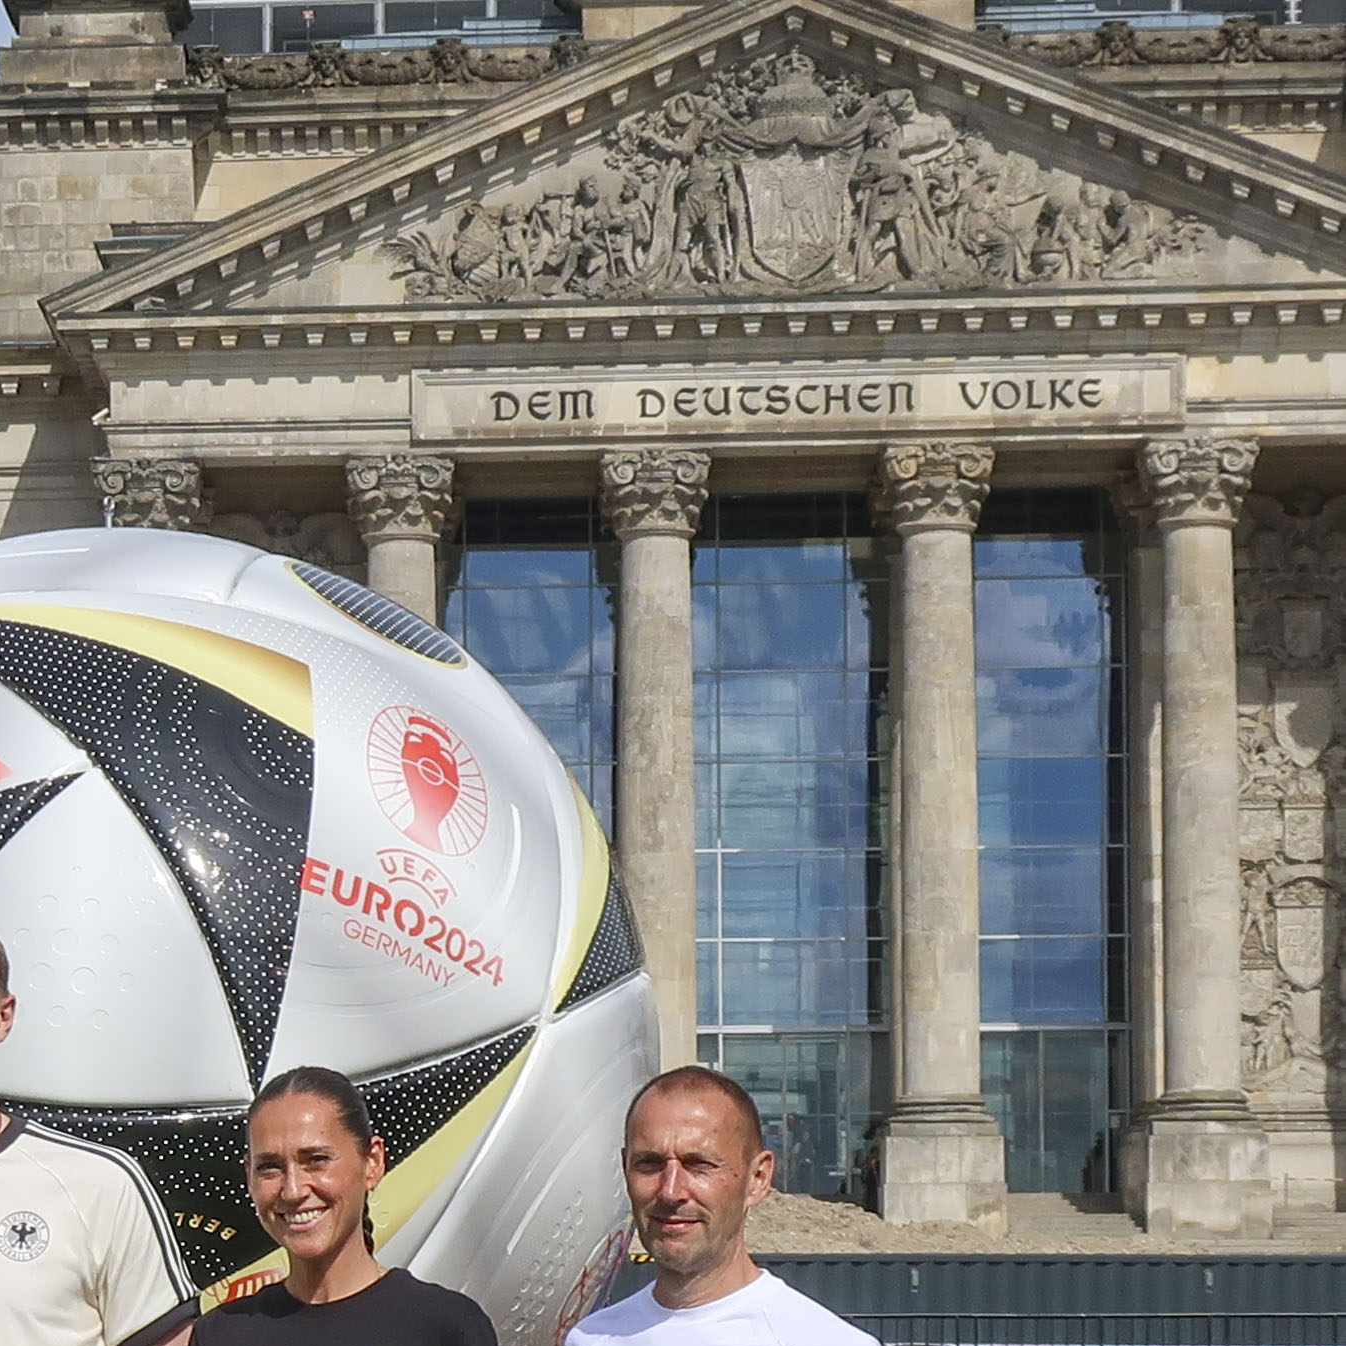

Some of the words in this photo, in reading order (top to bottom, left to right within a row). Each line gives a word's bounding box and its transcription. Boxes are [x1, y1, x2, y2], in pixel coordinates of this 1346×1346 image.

[489, 388, 595, 422] DEM
[636, 382, 915, 419] DEUTSCHEN
[958, 378, 1103, 411] VOLKE
[380, 855, 449, 906] UEFA
[299, 856, 504, 988] EURO2024
[343, 919, 456, 988] GERMANY
